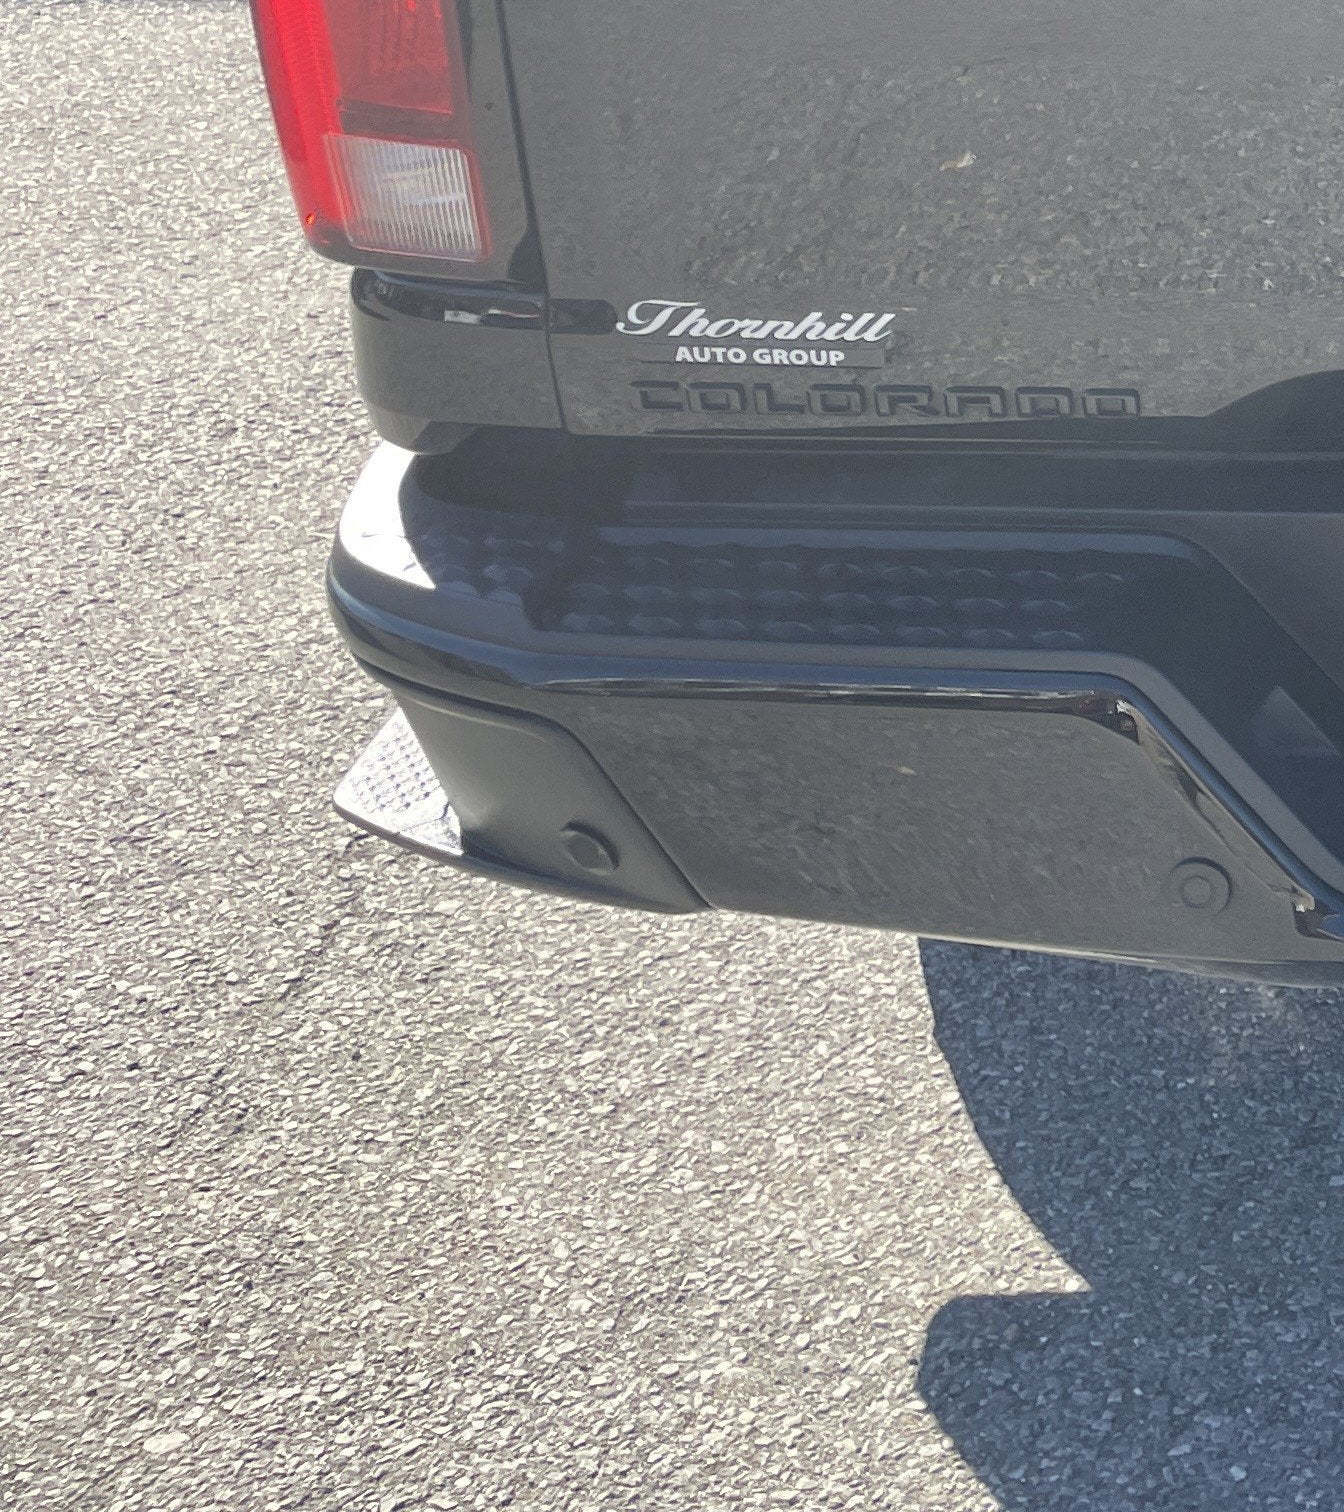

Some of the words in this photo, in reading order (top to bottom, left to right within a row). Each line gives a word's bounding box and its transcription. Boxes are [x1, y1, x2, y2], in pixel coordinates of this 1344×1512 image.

[616, 299, 899, 343] Thornhill
[675, 345, 747, 365] AUTO
[752, 347, 846, 368] GROUP
[630, 379, 1142, 418] COLORADO
